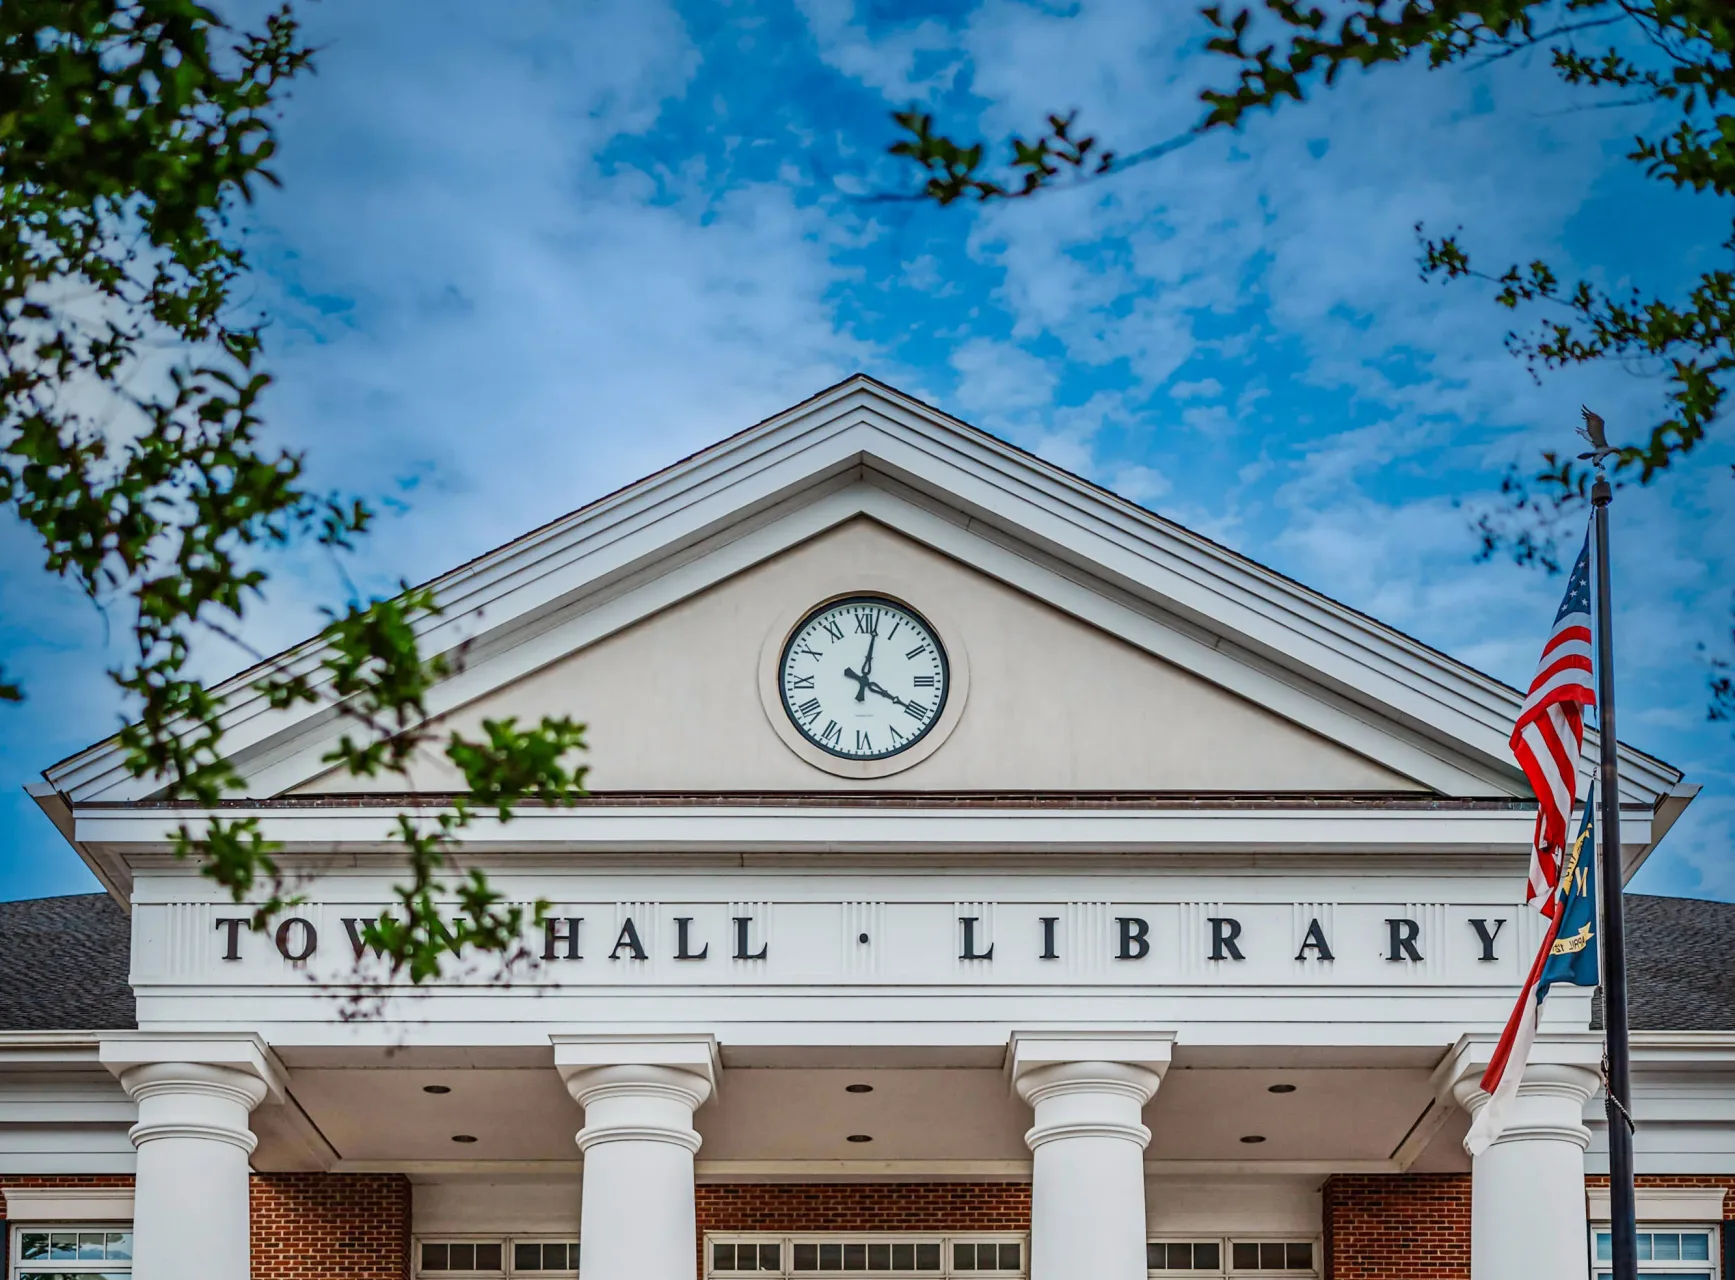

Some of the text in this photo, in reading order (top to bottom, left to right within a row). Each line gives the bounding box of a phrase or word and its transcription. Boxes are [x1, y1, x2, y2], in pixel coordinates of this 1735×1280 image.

[823, 620, 844, 644] XI
[855, 613, 874, 635] XII
[801, 644, 823, 662] X
[905, 644, 926, 660] II
[794, 675, 814, 689] IX
[914, 676, 934, 687] III
[539, 917, 769, 961] HALL
[958, 917, 1507, 961] LIBRARY
